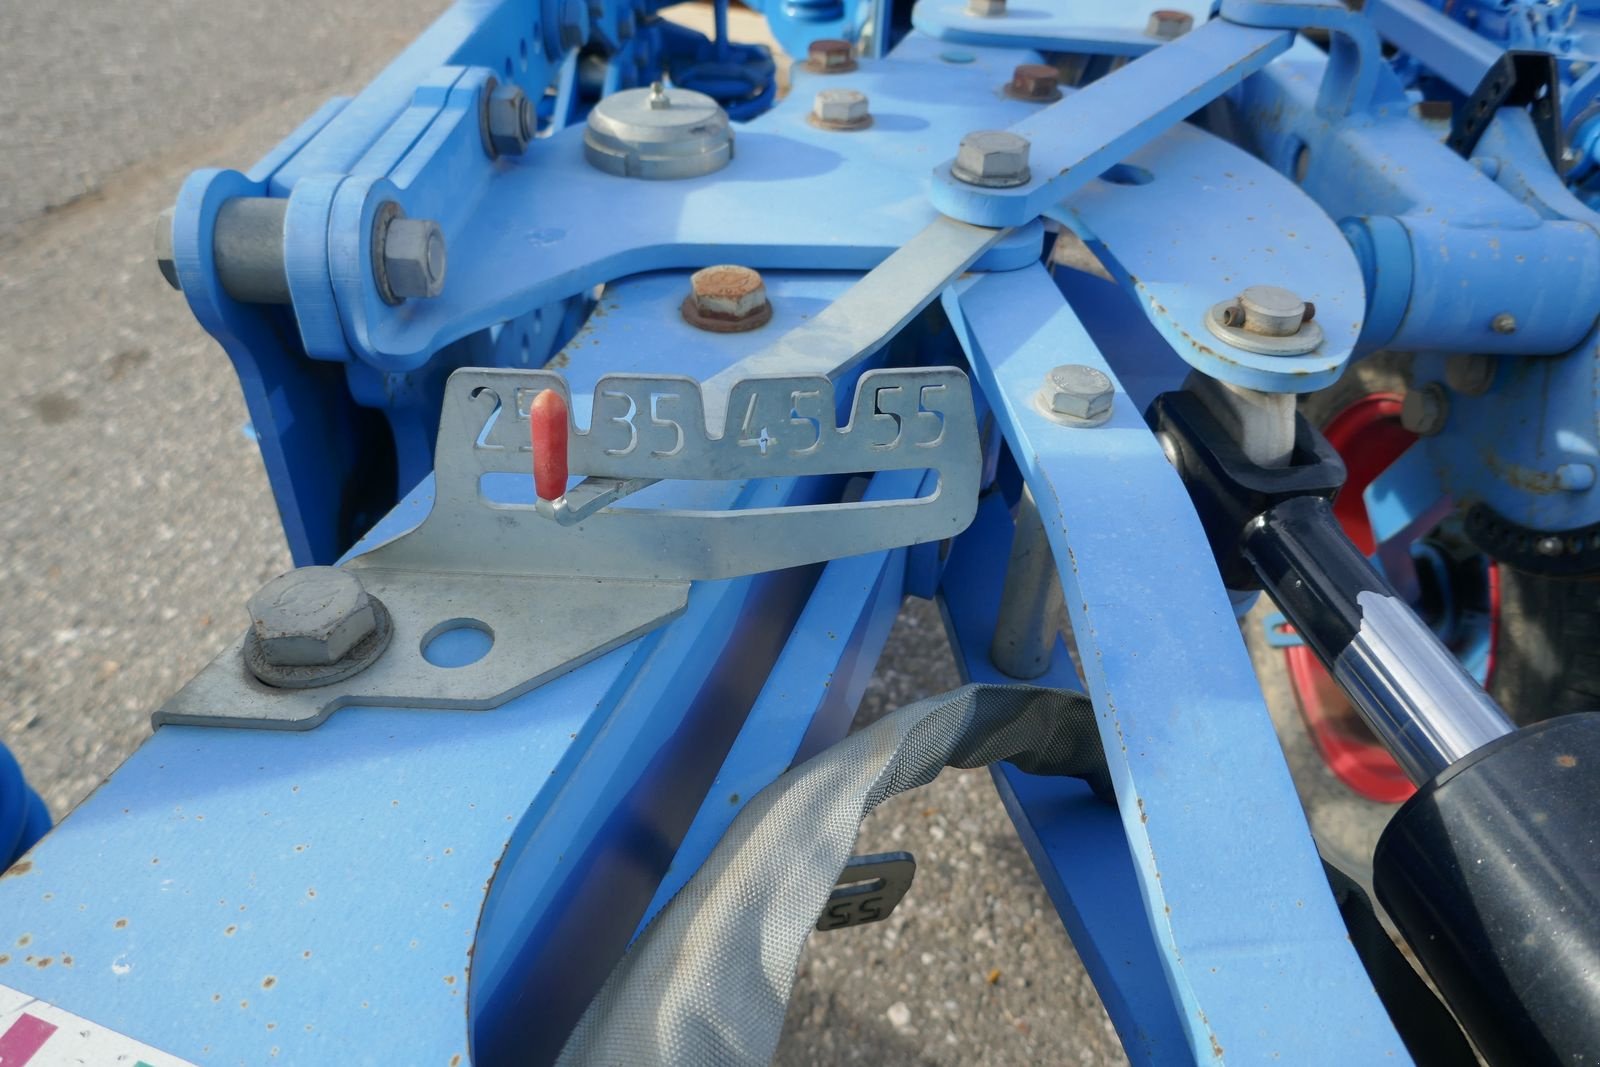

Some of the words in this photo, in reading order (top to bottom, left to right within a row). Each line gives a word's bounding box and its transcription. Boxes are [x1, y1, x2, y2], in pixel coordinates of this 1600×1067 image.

[602, 390, 684, 457] 35
[737, 390, 822, 456] 45
[871, 384, 946, 450] 55
